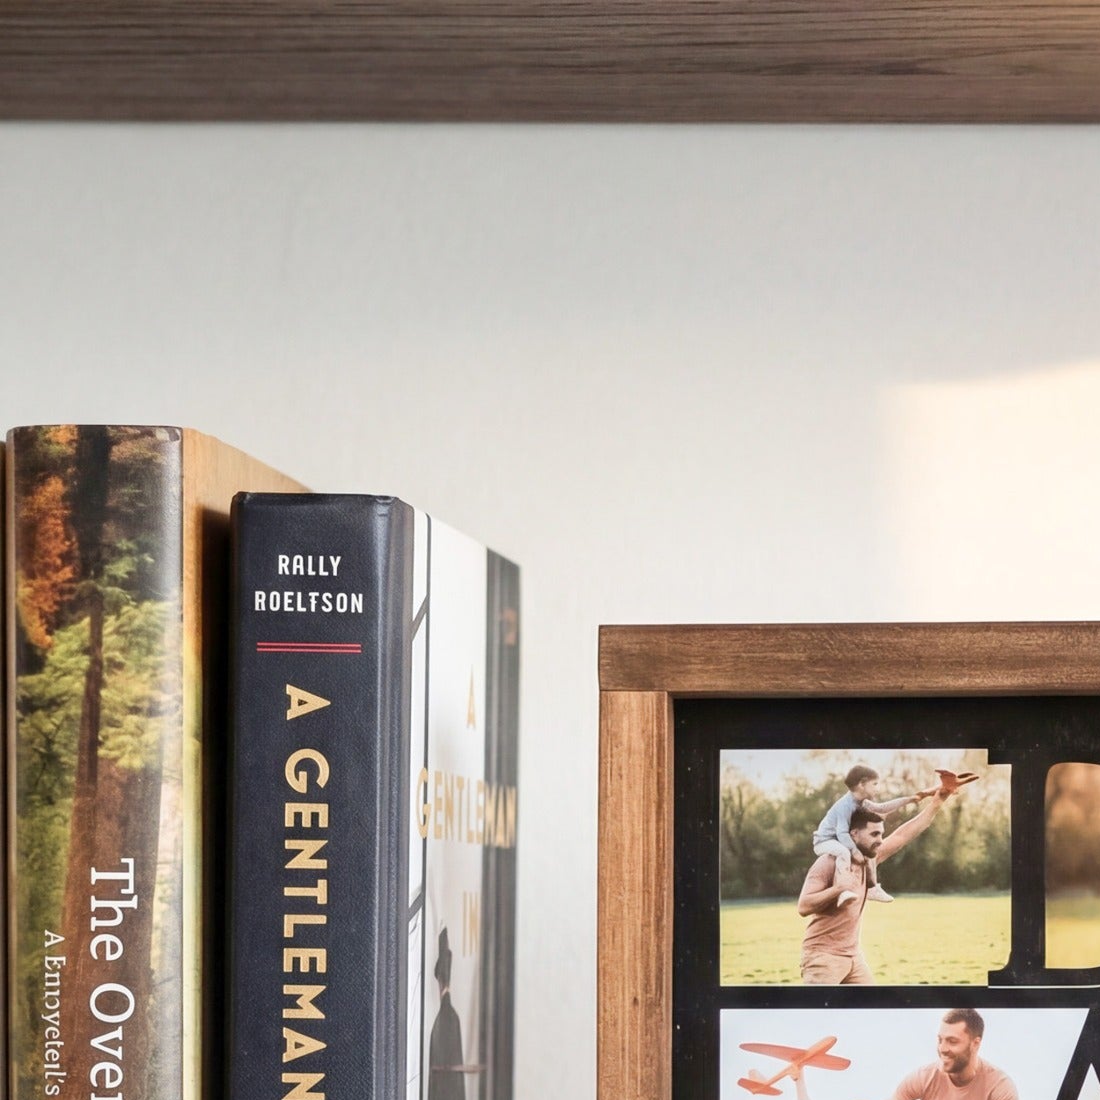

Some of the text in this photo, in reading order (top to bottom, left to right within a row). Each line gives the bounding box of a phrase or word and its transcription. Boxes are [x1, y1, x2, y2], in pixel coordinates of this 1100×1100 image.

[278, 554, 341, 576] RALLY
[254, 590, 363, 613] ROELTSON
[285, 683, 331, 721] A
[466, 664, 477, 729] A
[416, 767, 517, 848] GENTLEMAN
[90, 857, 138, 961] The
[462, 891, 480, 957] IN
[44, 929, 66, 948] A
